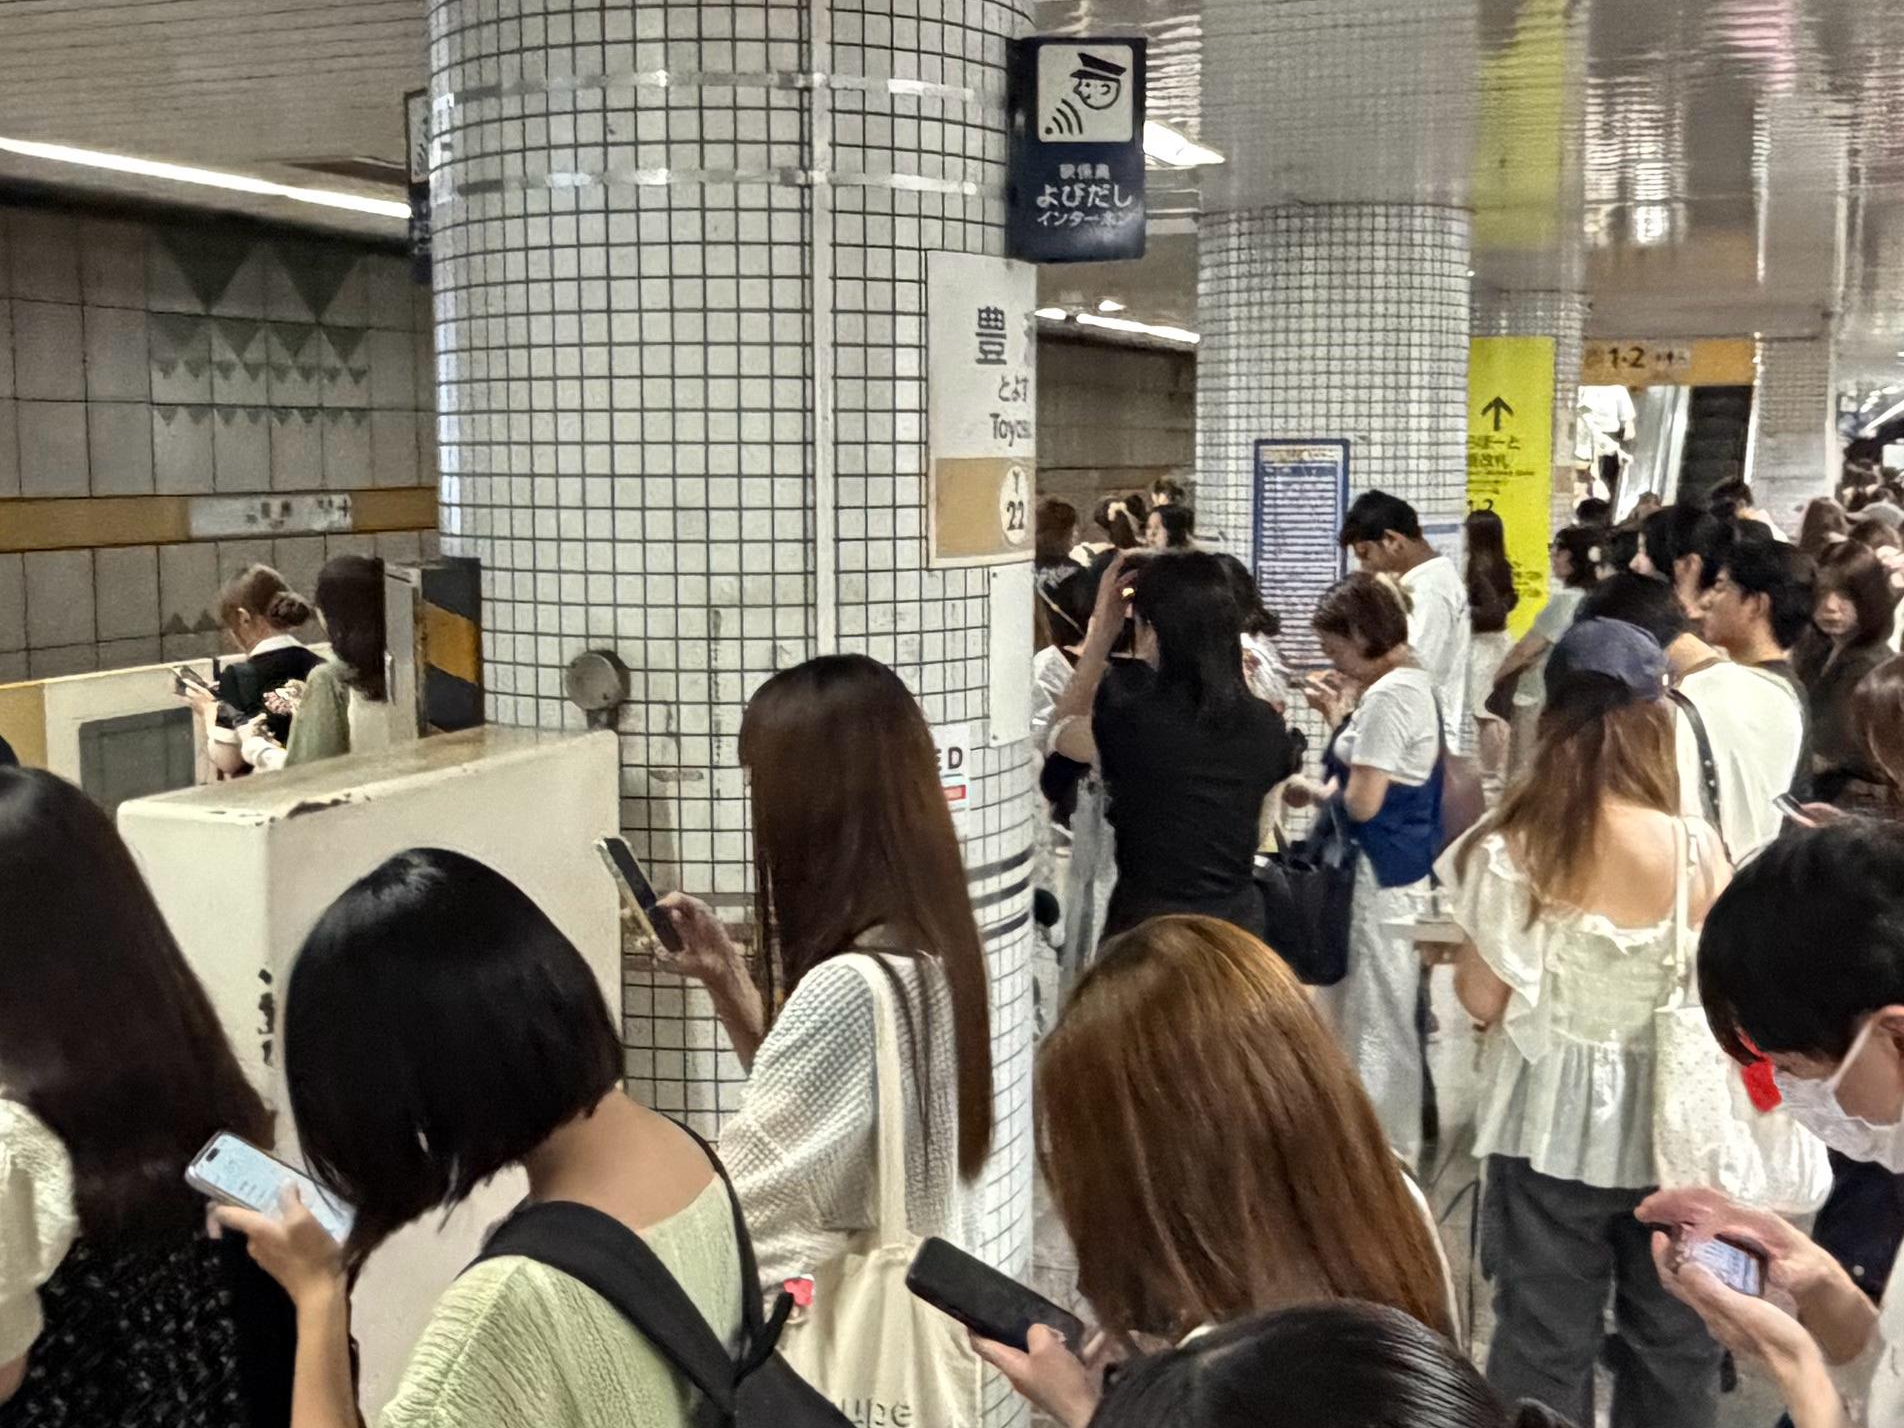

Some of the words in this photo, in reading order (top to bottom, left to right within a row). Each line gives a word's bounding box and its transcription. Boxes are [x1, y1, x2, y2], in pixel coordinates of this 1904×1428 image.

[1037, 183, 1132, 208] よびだし
[1006, 501, 1025, 530] 22
